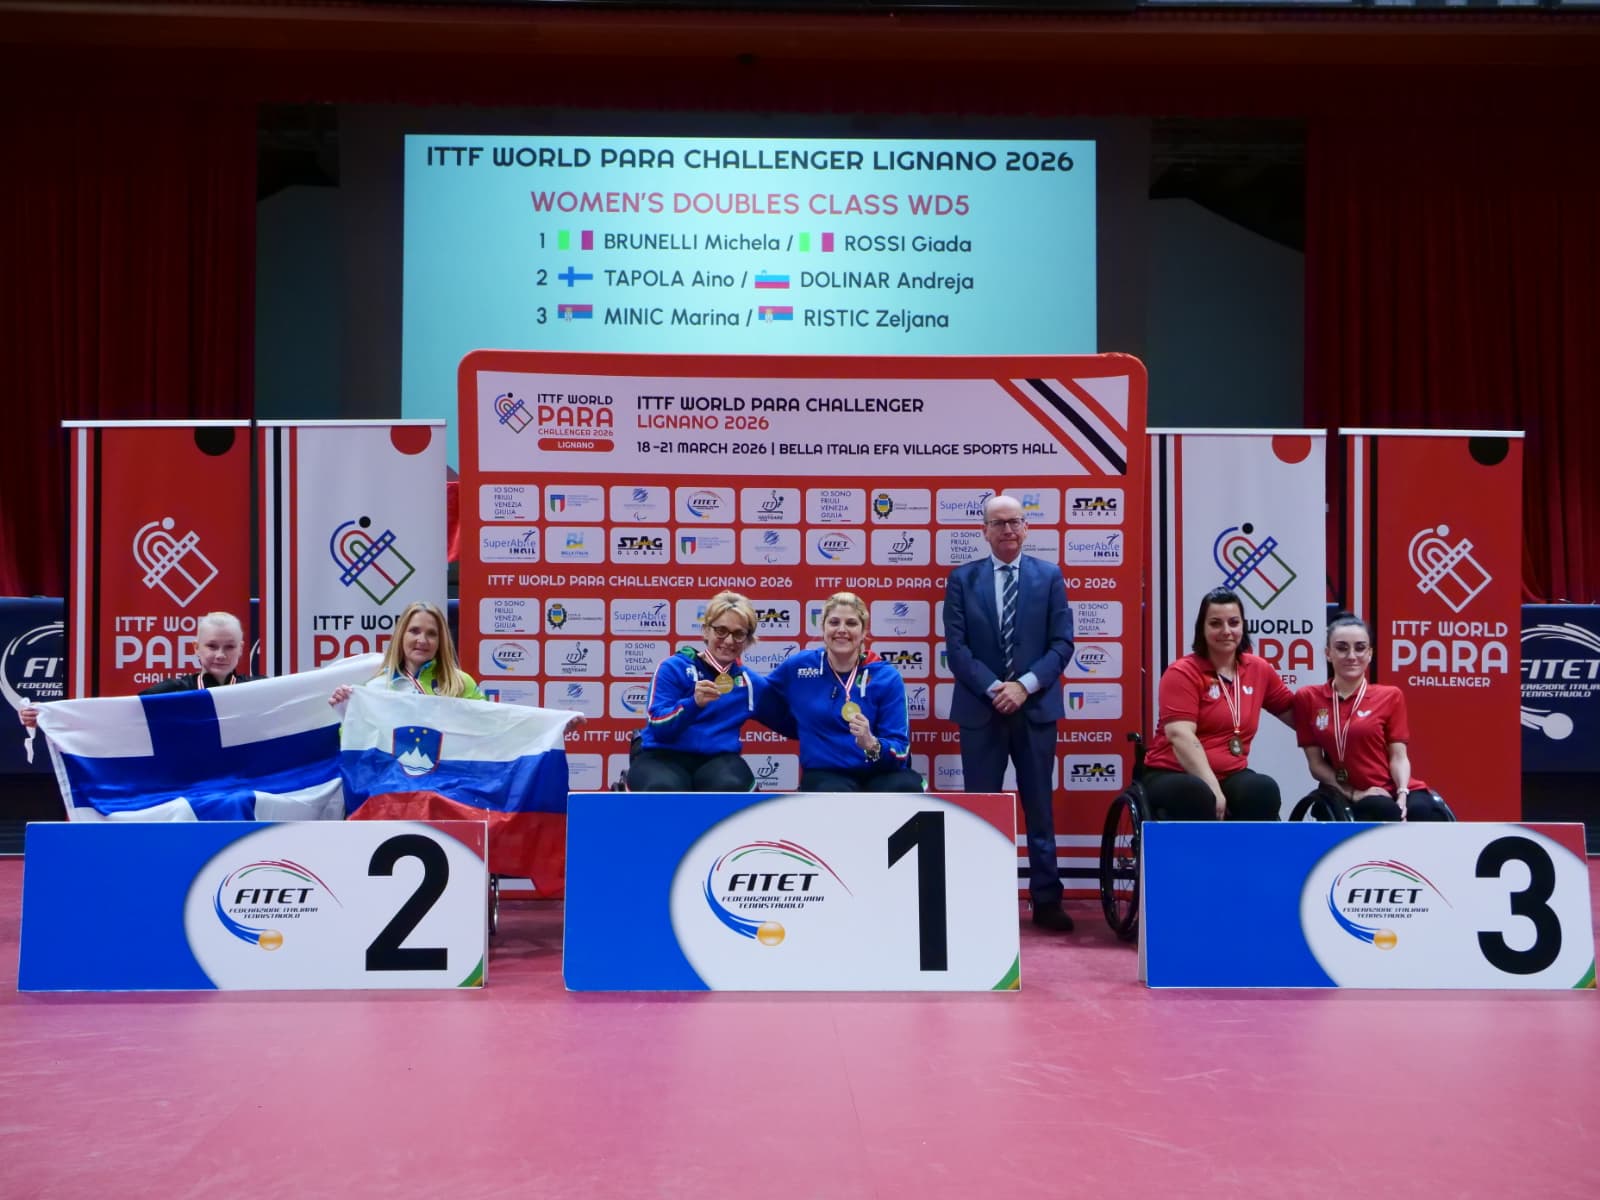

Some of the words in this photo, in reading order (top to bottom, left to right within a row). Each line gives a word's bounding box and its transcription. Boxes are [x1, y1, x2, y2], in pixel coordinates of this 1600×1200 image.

[427, 146, 484, 166] ITTF
[492, 147, 591, 168] WORLD
[600, 149, 675, 169] PARA
[684, 149, 864, 171] CHALLENGER
[873, 151, 997, 171] LIGNANO
[1005, 151, 1074, 172] 2026
[530, 191, 664, 214] WOMEN'S
[673, 193, 800, 215] DOUBLES
[809, 193, 899, 215] CLASS
[907, 194, 970, 216] WD5
[539, 232, 546, 249] 1
[604, 233, 698, 250] BRUNELLI
[705, 233, 780, 251] Michela
[844, 235, 906, 252] ROSSI
[911, 235, 972, 253] Giada
[536, 269, 548, 287] 2
[604, 270, 685, 287] TAPOLA
[691, 269, 734, 288] Aino
[800, 271, 890, 289] DOLINAR
[897, 272, 974, 295] Andreja
[536, 307, 548, 326] 3
[604, 307, 664, 326] MINIC
[671, 308, 740, 327] Marina
[804, 309, 869, 327] RISTIC
[875, 309, 949, 333] Zeljana
[538, 393, 564, 404] ITTF
[568, 394, 613, 405] WORLD
[637, 396, 675, 410] ITTF
[680, 397, 745, 411] WORLD
[751, 398, 800, 412] PARA
[806, 398, 924, 412] CHALLENGER
[538, 405, 613, 427] PARA
[637, 415, 719, 429] LIGNANO
[724, 416, 770, 430] 2026
[538, 428, 591, 436] CHALLENGER
[593, 429, 614, 437] 2026
[558, 441, 594, 449] LIGNANO
[637, 441, 650, 453] 18
[677, 442, 728, 454] MARCH
[732, 443, 767, 455] 2026
[779, 444, 823, 455] BELLA
[827, 444, 870, 455] ITALIA
[873, 444, 899, 455] EFA
[903, 444, 960, 455] VILLAGE
[963, 443, 1018, 455] SPORTS
[1022, 443, 1058, 454] HALL
[1072, 496, 1117, 510] STAG
[617, 536, 663, 549] STAG
[488, 575, 515, 586] ITTF
[518, 575, 566, 586] WORLD
[569, 575, 605, 586] PARA
[608, 575, 694, 587] CHALLENGER
[698, 576, 756, 588] LIGNANO
[760, 577, 793, 588] 2026
[815, 577, 843, 588] ITTF
[846, 577, 893, 588] WORLD
[896, 577, 932, 588] PARA
[1084, 578, 1117, 589] 2026
[755, 608, 790, 620] TAG
[115, 616, 157, 632] ITTF
[313, 615, 354, 630] ITTF
[1391, 621, 1432, 636] ITTF
[1438, 621, 1508, 637] WORLD
[115, 635, 201, 669] PAR
[1259, 638, 1314, 670] RA
[1391, 639, 1508, 673] PARA
[1408, 675, 1490, 687] CHALLENGER
[583, 731, 610, 742] ITTF
[911, 731, 938, 742] ITTF
[1056, 731, 1112, 742] LLENGER
[1071, 763, 1115, 775] STAG
[728, 873, 819, 892] FITET
[235, 888, 314, 904] FITET
[887, 810, 948, 972] 1
[1347, 888, 1423, 904] FITET
[365, 833, 450, 972] 2
[1475, 835, 1562, 976] 3
